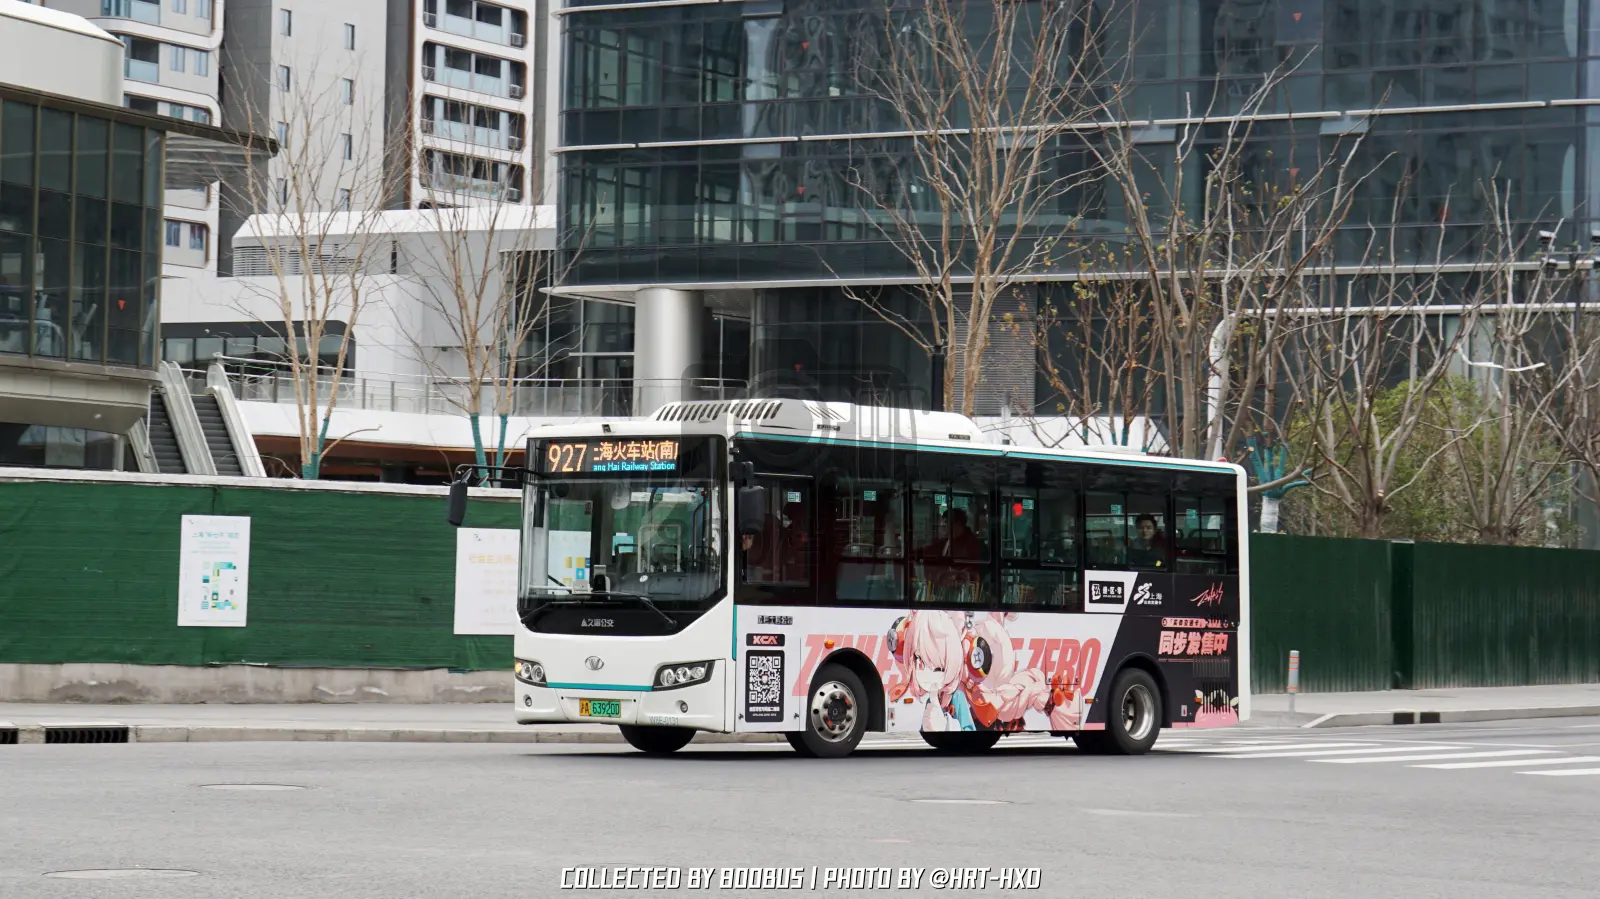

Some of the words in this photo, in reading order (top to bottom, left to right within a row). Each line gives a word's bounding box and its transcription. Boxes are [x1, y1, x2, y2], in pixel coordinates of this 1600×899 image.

[549, 444, 587, 472] 927
[607, 462, 619, 471] Hai
[621, 461, 649, 471] Railway
[650, 461, 675, 470] Station
[1158, 630, 1229, 655] 同步发售中
[1027, 637, 1101, 697] ZERO
